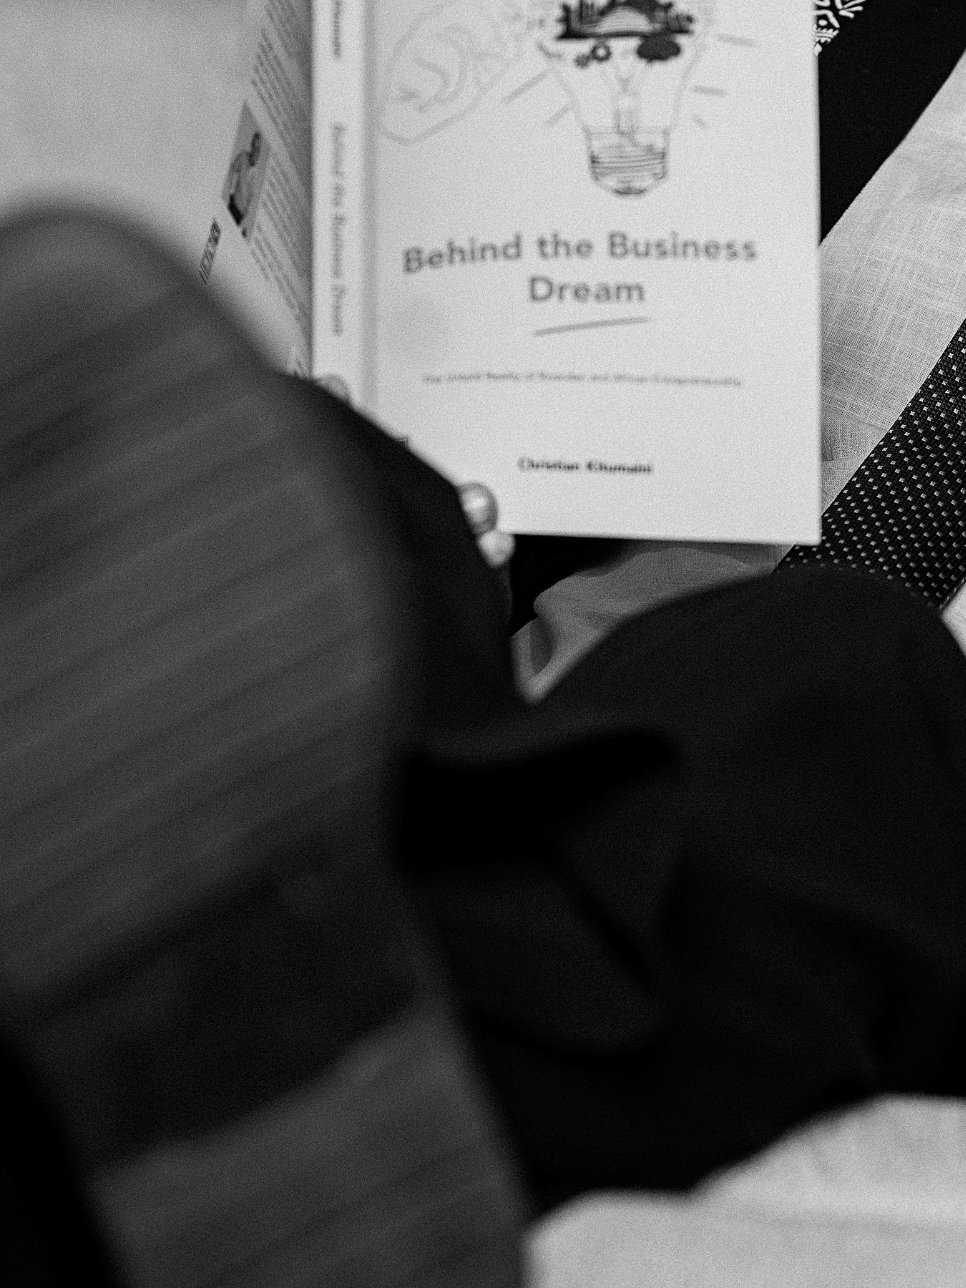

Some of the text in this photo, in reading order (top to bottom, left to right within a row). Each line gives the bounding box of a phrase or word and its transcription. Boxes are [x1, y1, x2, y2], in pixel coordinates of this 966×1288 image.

[403, 230, 758, 274] Behind the Business
[528, 275, 646, 303] Dream
